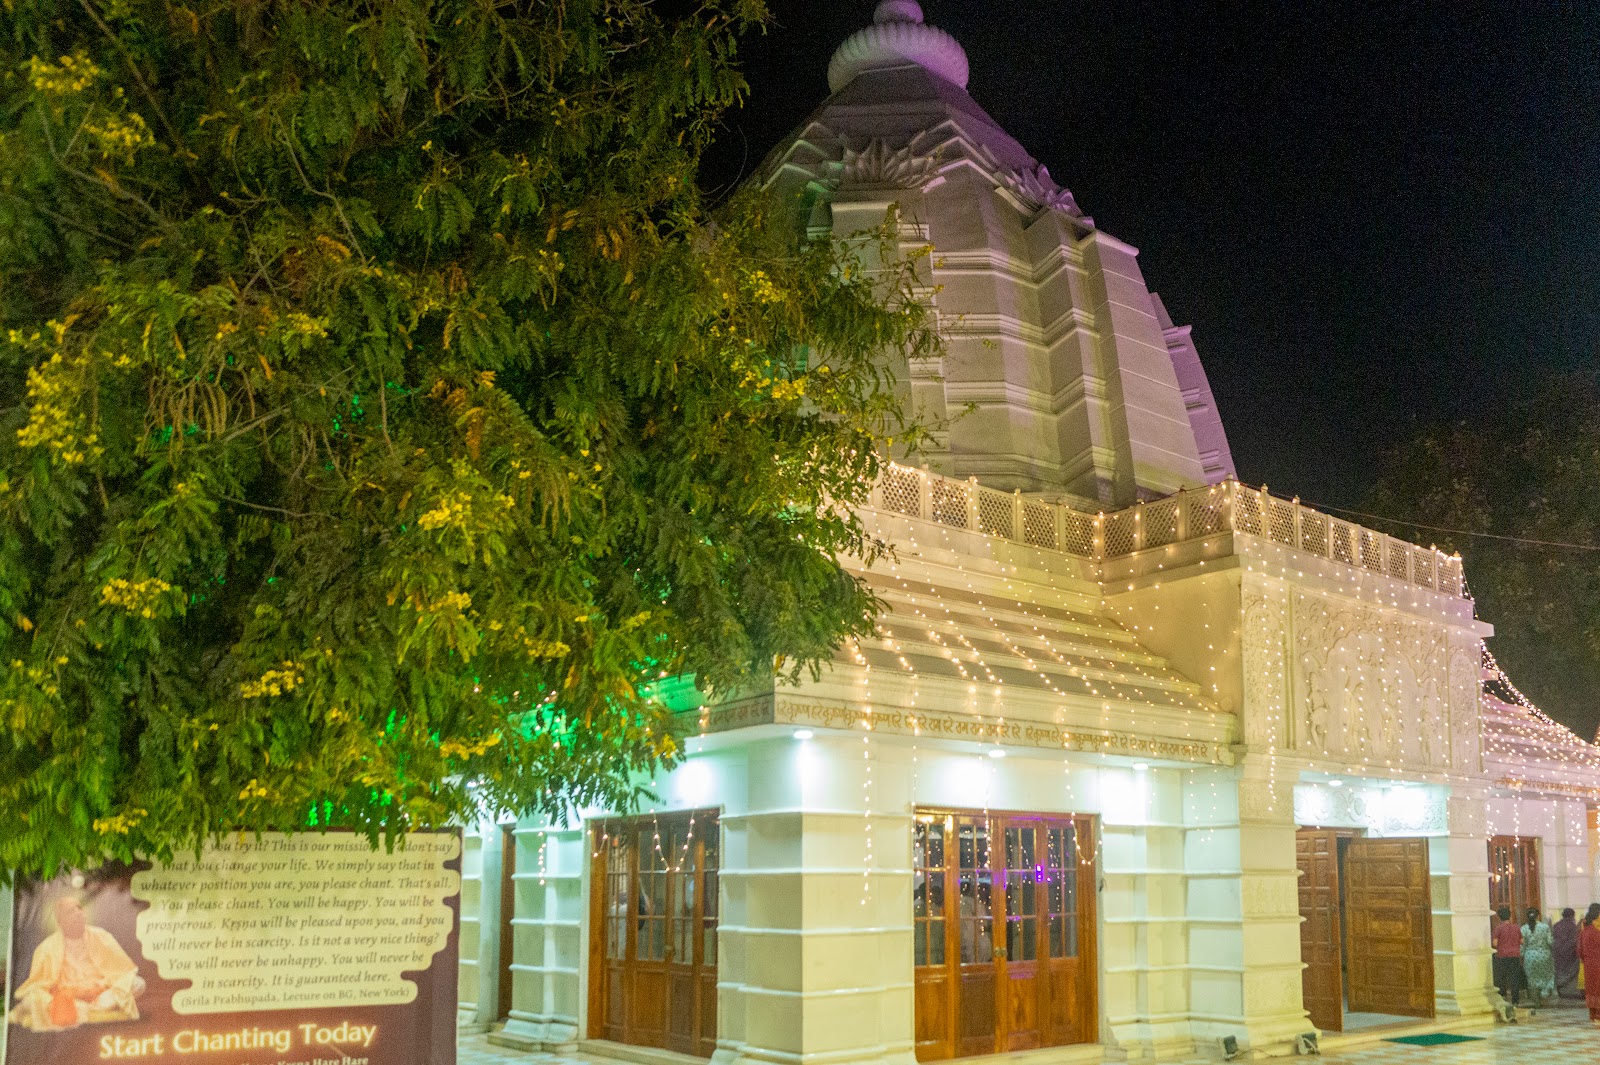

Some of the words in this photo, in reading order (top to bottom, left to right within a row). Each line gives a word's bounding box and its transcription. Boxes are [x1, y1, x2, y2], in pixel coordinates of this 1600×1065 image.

[255, 840, 269, 851] it?
[271, 839, 296, 851] This
[300, 839, 309, 850] is
[312, 841, 330, 850] our
[434, 841, 454, 854] say
[189, 861, 212, 874] you
[215, 859, 257, 874] change
[258, 861, 288, 874] your
[289, 858, 311, 873] life.
[315, 860, 335, 870] We
[336, 859, 375, 873] simply
[377, 861, 396, 873] say
[398, 859, 420, 870] that
[422, 859, 435, 870] in
[141, 879, 197, 891] whatever
[199, 878, 247, 893] position
[250, 880, 272, 892] you
[274, 881, 295, 892] are,
[300, 880, 320, 892] you
[322, 878, 356, 892] please
[357, 878, 394, 889] chant.
[398, 877, 431, 889] That's
[433, 876, 453, 889] all.
[160, 899, 185, 910] You
[187, 898, 223, 912] please
[226, 898, 264, 910] chant.
[268, 898, 291, 909] You
[292, 897, 316, 908] will
[317, 896, 331, 908] be
[333, 896, 373, 910] happy.
[376, 897, 396, 907] You
[399, 895, 421, 907] will
[422, 895, 435, 907] be
[145, 919, 216, 933] prosperous.
[259, 915, 282, 928] will
[284, 915, 297, 928] be
[300, 914, 342, 930] pleased
[345, 917, 373, 929] upon
[374, 916, 399, 929] you,
[401, 914, 424, 926] and
[424, 915, 445, 928] you
[152, 937, 176, 951] will
[178, 939, 212, 950] never
[214, 936, 228, 949] be
[231, 937, 243, 949] in
[246, 936, 295, 950] scarcity.
[300, 935, 310, 946] Is
[312, 934, 321, 946] it
[323, 935, 342, 946] not
[344, 936, 352, 945] a
[354, 935, 378, 948] very
[380, 932, 402, 945] nice
[404, 931, 440, 946] thing?
[169, 959, 191, 970] You
[194, 956, 218, 969] will
[221, 957, 254, 968] never
[256, 954, 270, 967] be
[272, 953, 328, 969] unhappy.
[332, 953, 352, 964] You
[355, 951, 377, 963] will
[379, 953, 410, 963] never
[411, 951, 425, 962] be
[202, 976, 215, 988] in
[218, 974, 268, 990] scarcity.
[272, 974, 283, 986] It
[285, 973, 295, 985] is
[296, 971, 362, 988] guaranteed
[363, 970, 391, 982] here.
[283, 990, 321, 1001] Lecture
[322, 990, 336, 999] on
[338, 989, 356, 1000] BG,
[359, 988, 381, 998] New
[383, 987, 410, 998] York)
[98, 1033, 165, 1059] Start
[172, 1026, 292, 1053] Chanting
[298, 1020, 377, 1047] Today
